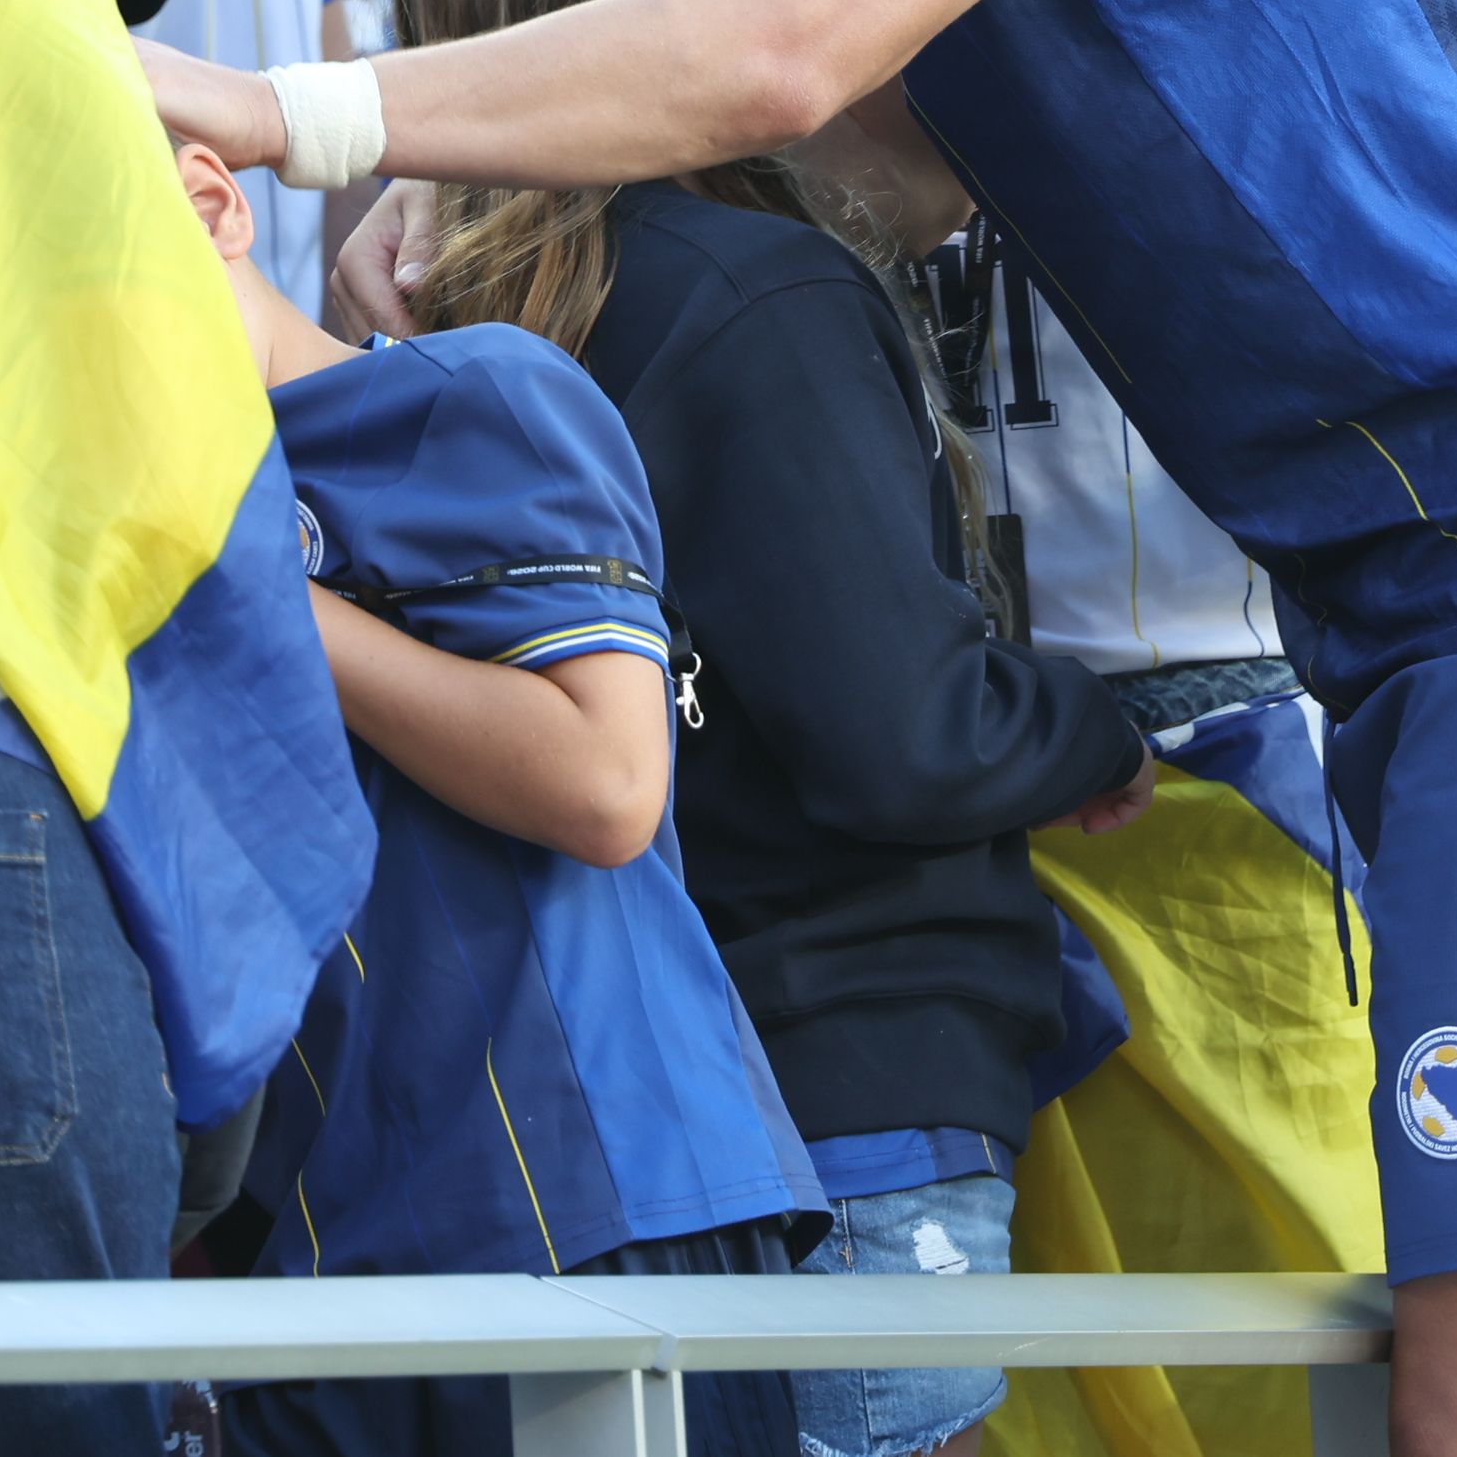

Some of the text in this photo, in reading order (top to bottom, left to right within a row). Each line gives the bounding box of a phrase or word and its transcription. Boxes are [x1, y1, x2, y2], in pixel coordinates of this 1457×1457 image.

[538, 564, 554, 572] CUP
[555, 564, 584, 572] WORLD
[584, 564, 601, 573] FIFA
